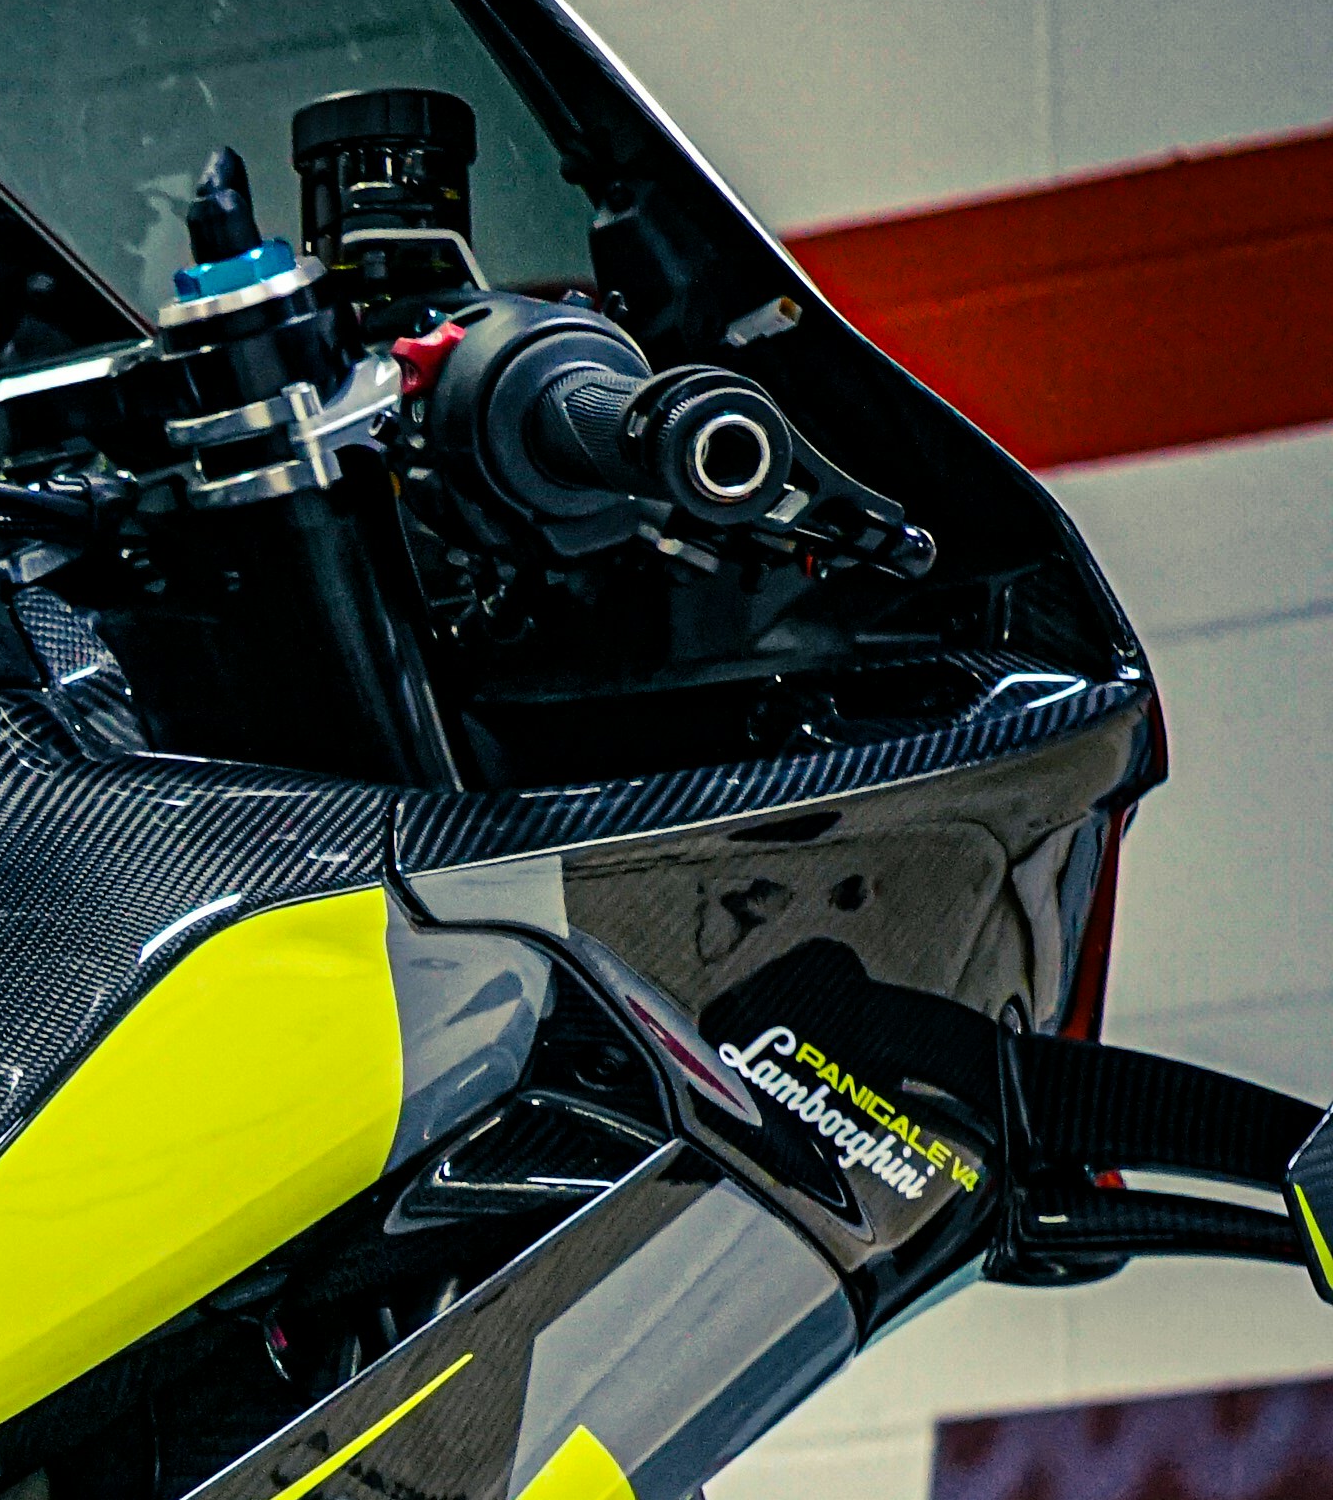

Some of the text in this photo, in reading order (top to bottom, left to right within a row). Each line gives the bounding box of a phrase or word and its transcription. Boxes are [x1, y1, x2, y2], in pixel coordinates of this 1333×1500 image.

[718, 1026, 938, 1200] Lamborghini
[795, 1041, 980, 1193] PANIGALE V4
